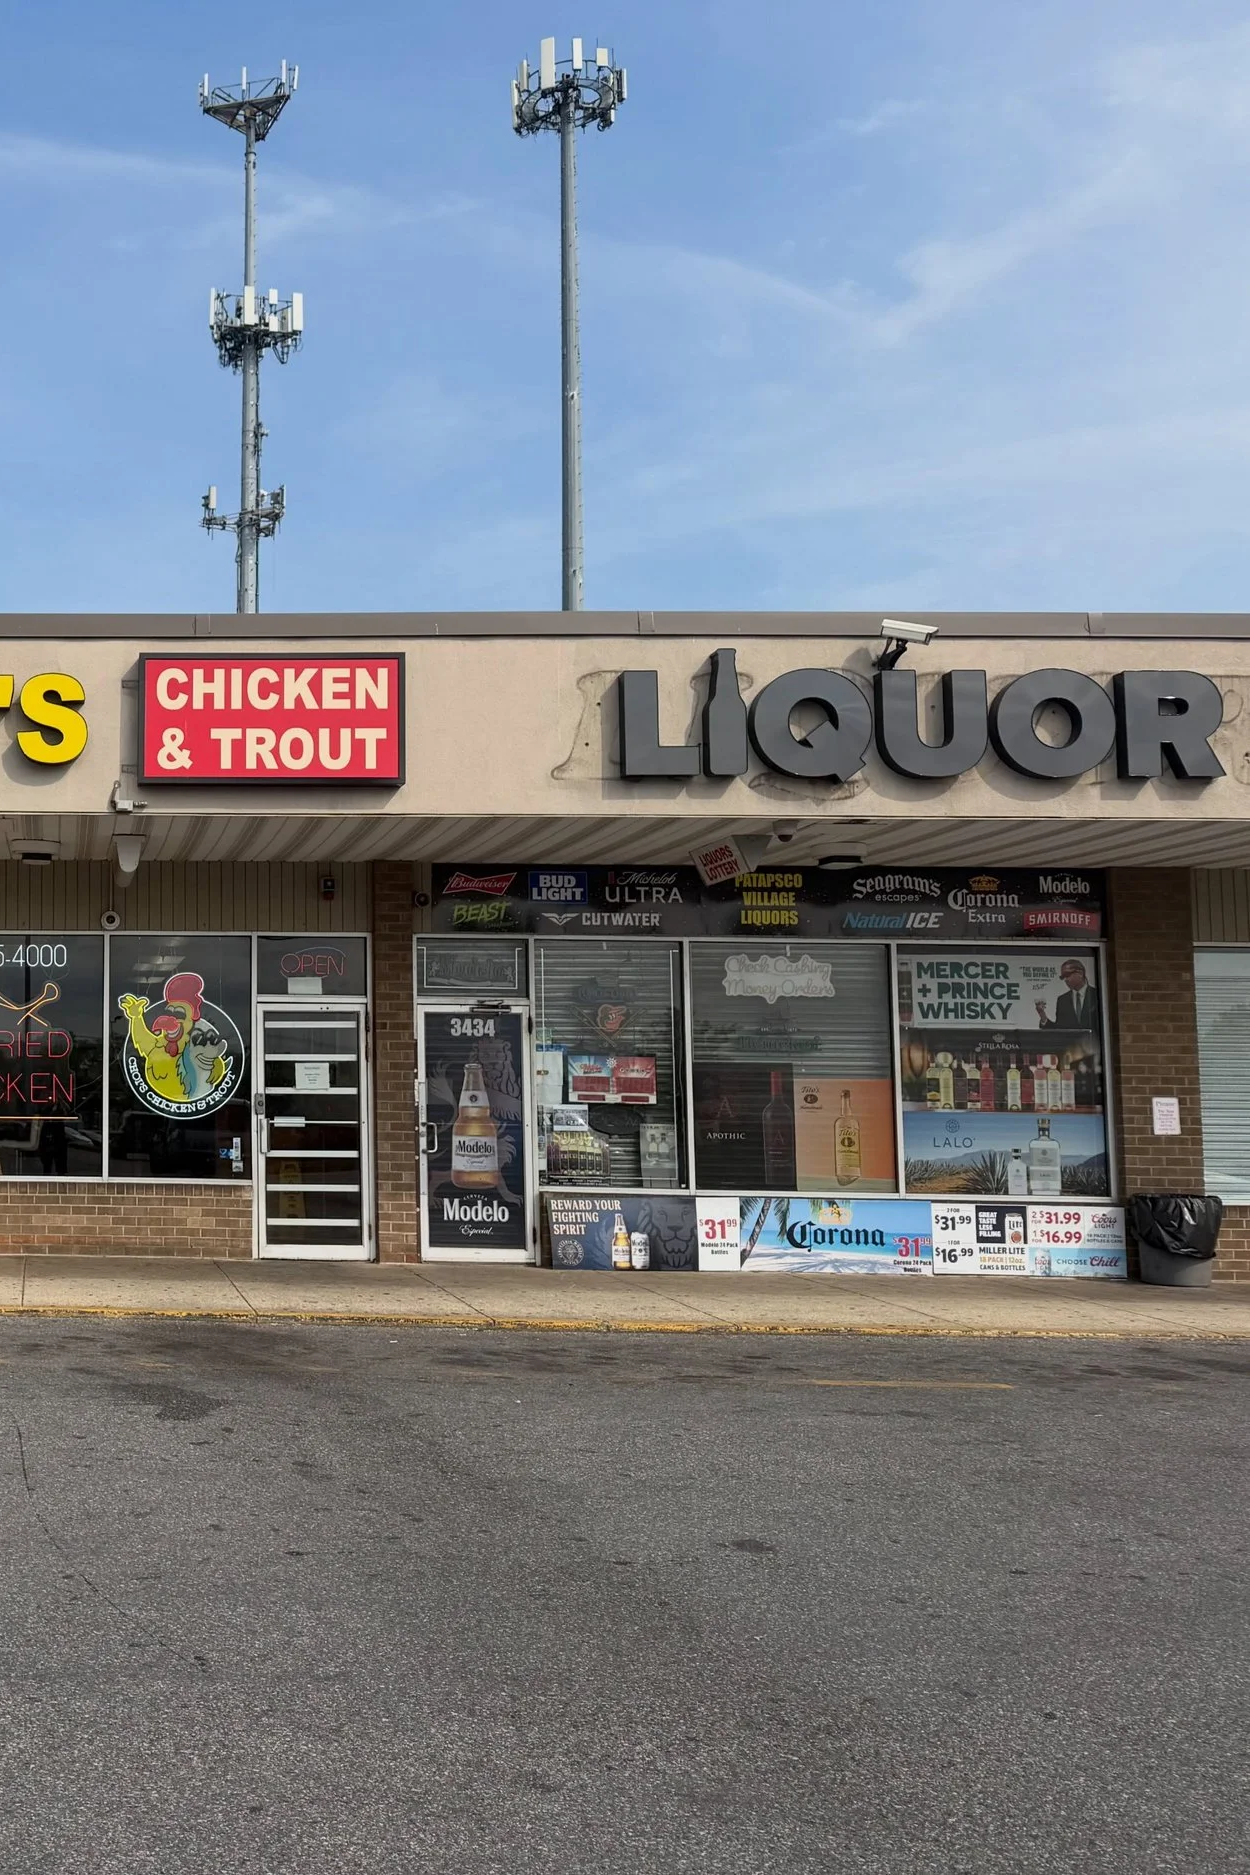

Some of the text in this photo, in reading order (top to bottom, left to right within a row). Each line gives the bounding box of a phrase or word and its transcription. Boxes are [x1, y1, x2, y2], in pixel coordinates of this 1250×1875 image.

[155, 667, 391, 712] CHICKEN
[156, 727, 389, 771] & TROUT
[698, 844, 735, 868] LIQUORS
[616, 871, 677, 885] Michelob
[704, 860, 742, 882] LOTTERY
[450, 876, 509, 888] Budweiser
[539, 874, 577, 888] BUD
[734, 873, 803, 889] PATAPSCO
[852, 873, 942, 899] Seagram's
[1039, 876, 1090, 894] Modelo
[532, 887, 584, 901] LIGHT
[605, 887, 683, 904] ULTRA
[743, 891, 796, 907] VILLAGE
[875, 893, 920, 904] escapes
[947, 888, 1021, 913] Corona
[453, 901, 513, 925] BEAST
[582, 912, 660, 927] CUTWATER
[741, 910, 799, 925] LIQUORS
[842, 912, 944, 929] Natural ICE
[968, 910, 1007, 923] Extra
[1029, 912, 1091, 926] SMIRNOFF
[280, 953, 346, 976] OPEN
[726, 955, 830, 980] Check Cashing
[916, 961, 1010, 980] MERCER
[724, 978, 833, 1003] Money Orders
[917, 985, 932, 998] +
[937, 982, 1021, 1000] PRINCE
[917, 1001, 1013, 1020] WHISKY
[450, 1018, 495, 1037] 3434
[978, 1042, 1020, 1050] STELLA ROSA
[128, 1056, 149, 1093] CHOI'S
[146, 1091, 197, 1113] CHICKEN
[206, 1071, 236, 1105] TROUT
[706, 1132, 747, 1140] APOTHIC
[932, 1137, 974, 1149] LALO
[458, 1140, 492, 1154] Modelo
[443, 1198, 510, 1222] Modelo
[551, 1200, 621, 1211] REWARD YOUR
[552, 1212, 599, 1223] FIGHTING
[934, 1214, 972, 1231] $31.99
[1008, 1219, 1023, 1229] Lite
[1031, 1211, 1082, 1225] 2 $31.99
[1091, 1214, 1117, 1224] Coors
[459, 1224, 493, 1237] Especial
[553, 1224, 586, 1235] SPIRIT
[786, 1220, 886, 1252] Corona
[1039, 1230, 1082, 1244] $16.99
[935, 1247, 974, 1263] $16.99
[1008, 1247, 1026, 1255] LITE
[1089, 1255, 1122, 1267] Chill
